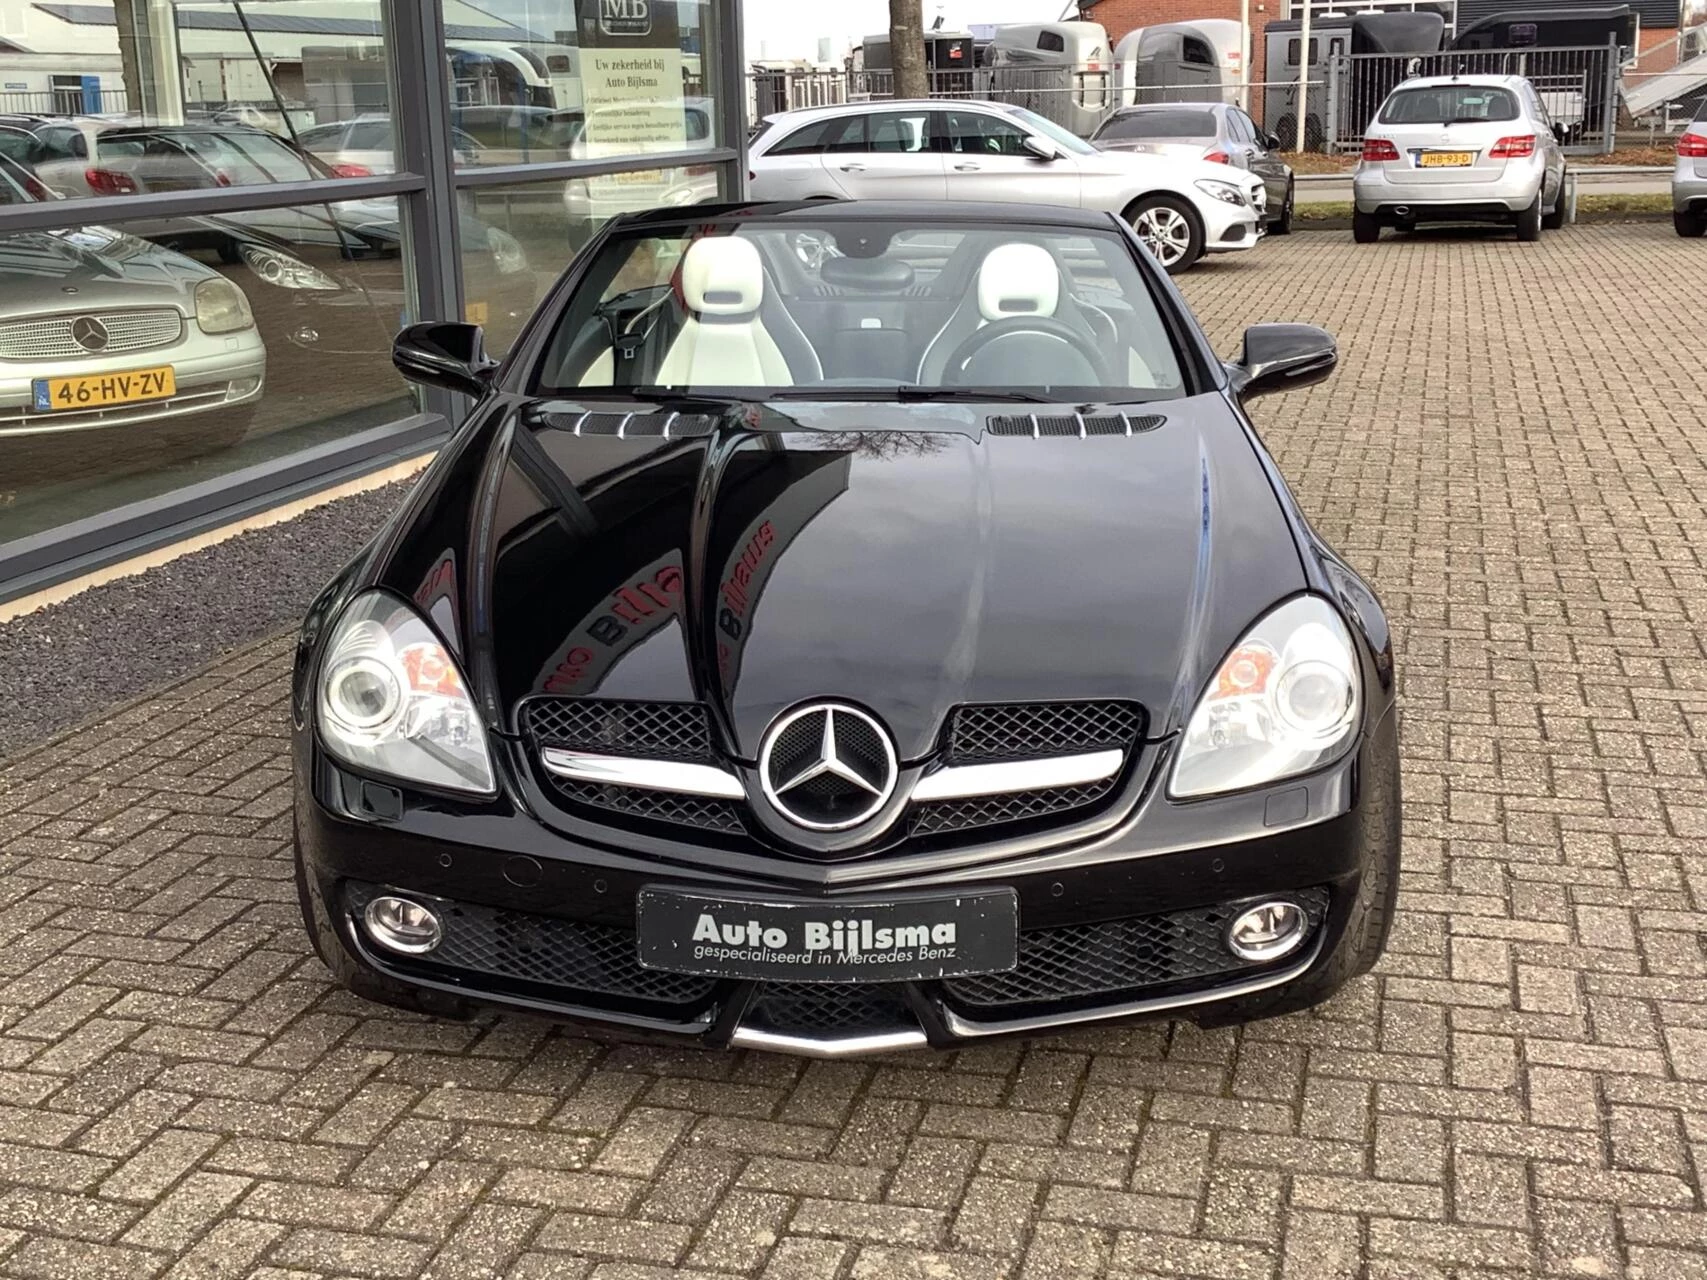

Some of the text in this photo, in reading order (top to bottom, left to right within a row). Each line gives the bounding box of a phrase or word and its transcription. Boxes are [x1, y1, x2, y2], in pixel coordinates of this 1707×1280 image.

[604, 0, 648, 18] MB
[612, 58, 652, 70] zekerheid
[653, 58, 665, 72] bij
[605, 76, 658, 90] Auto Bijlsma
[58, 371, 165, 404] 46-HV-ZV
[692, 913, 956, 957] Auto Bijlsma
[694, 945, 957, 965] gespecialiseerd in Mercedes Benz
